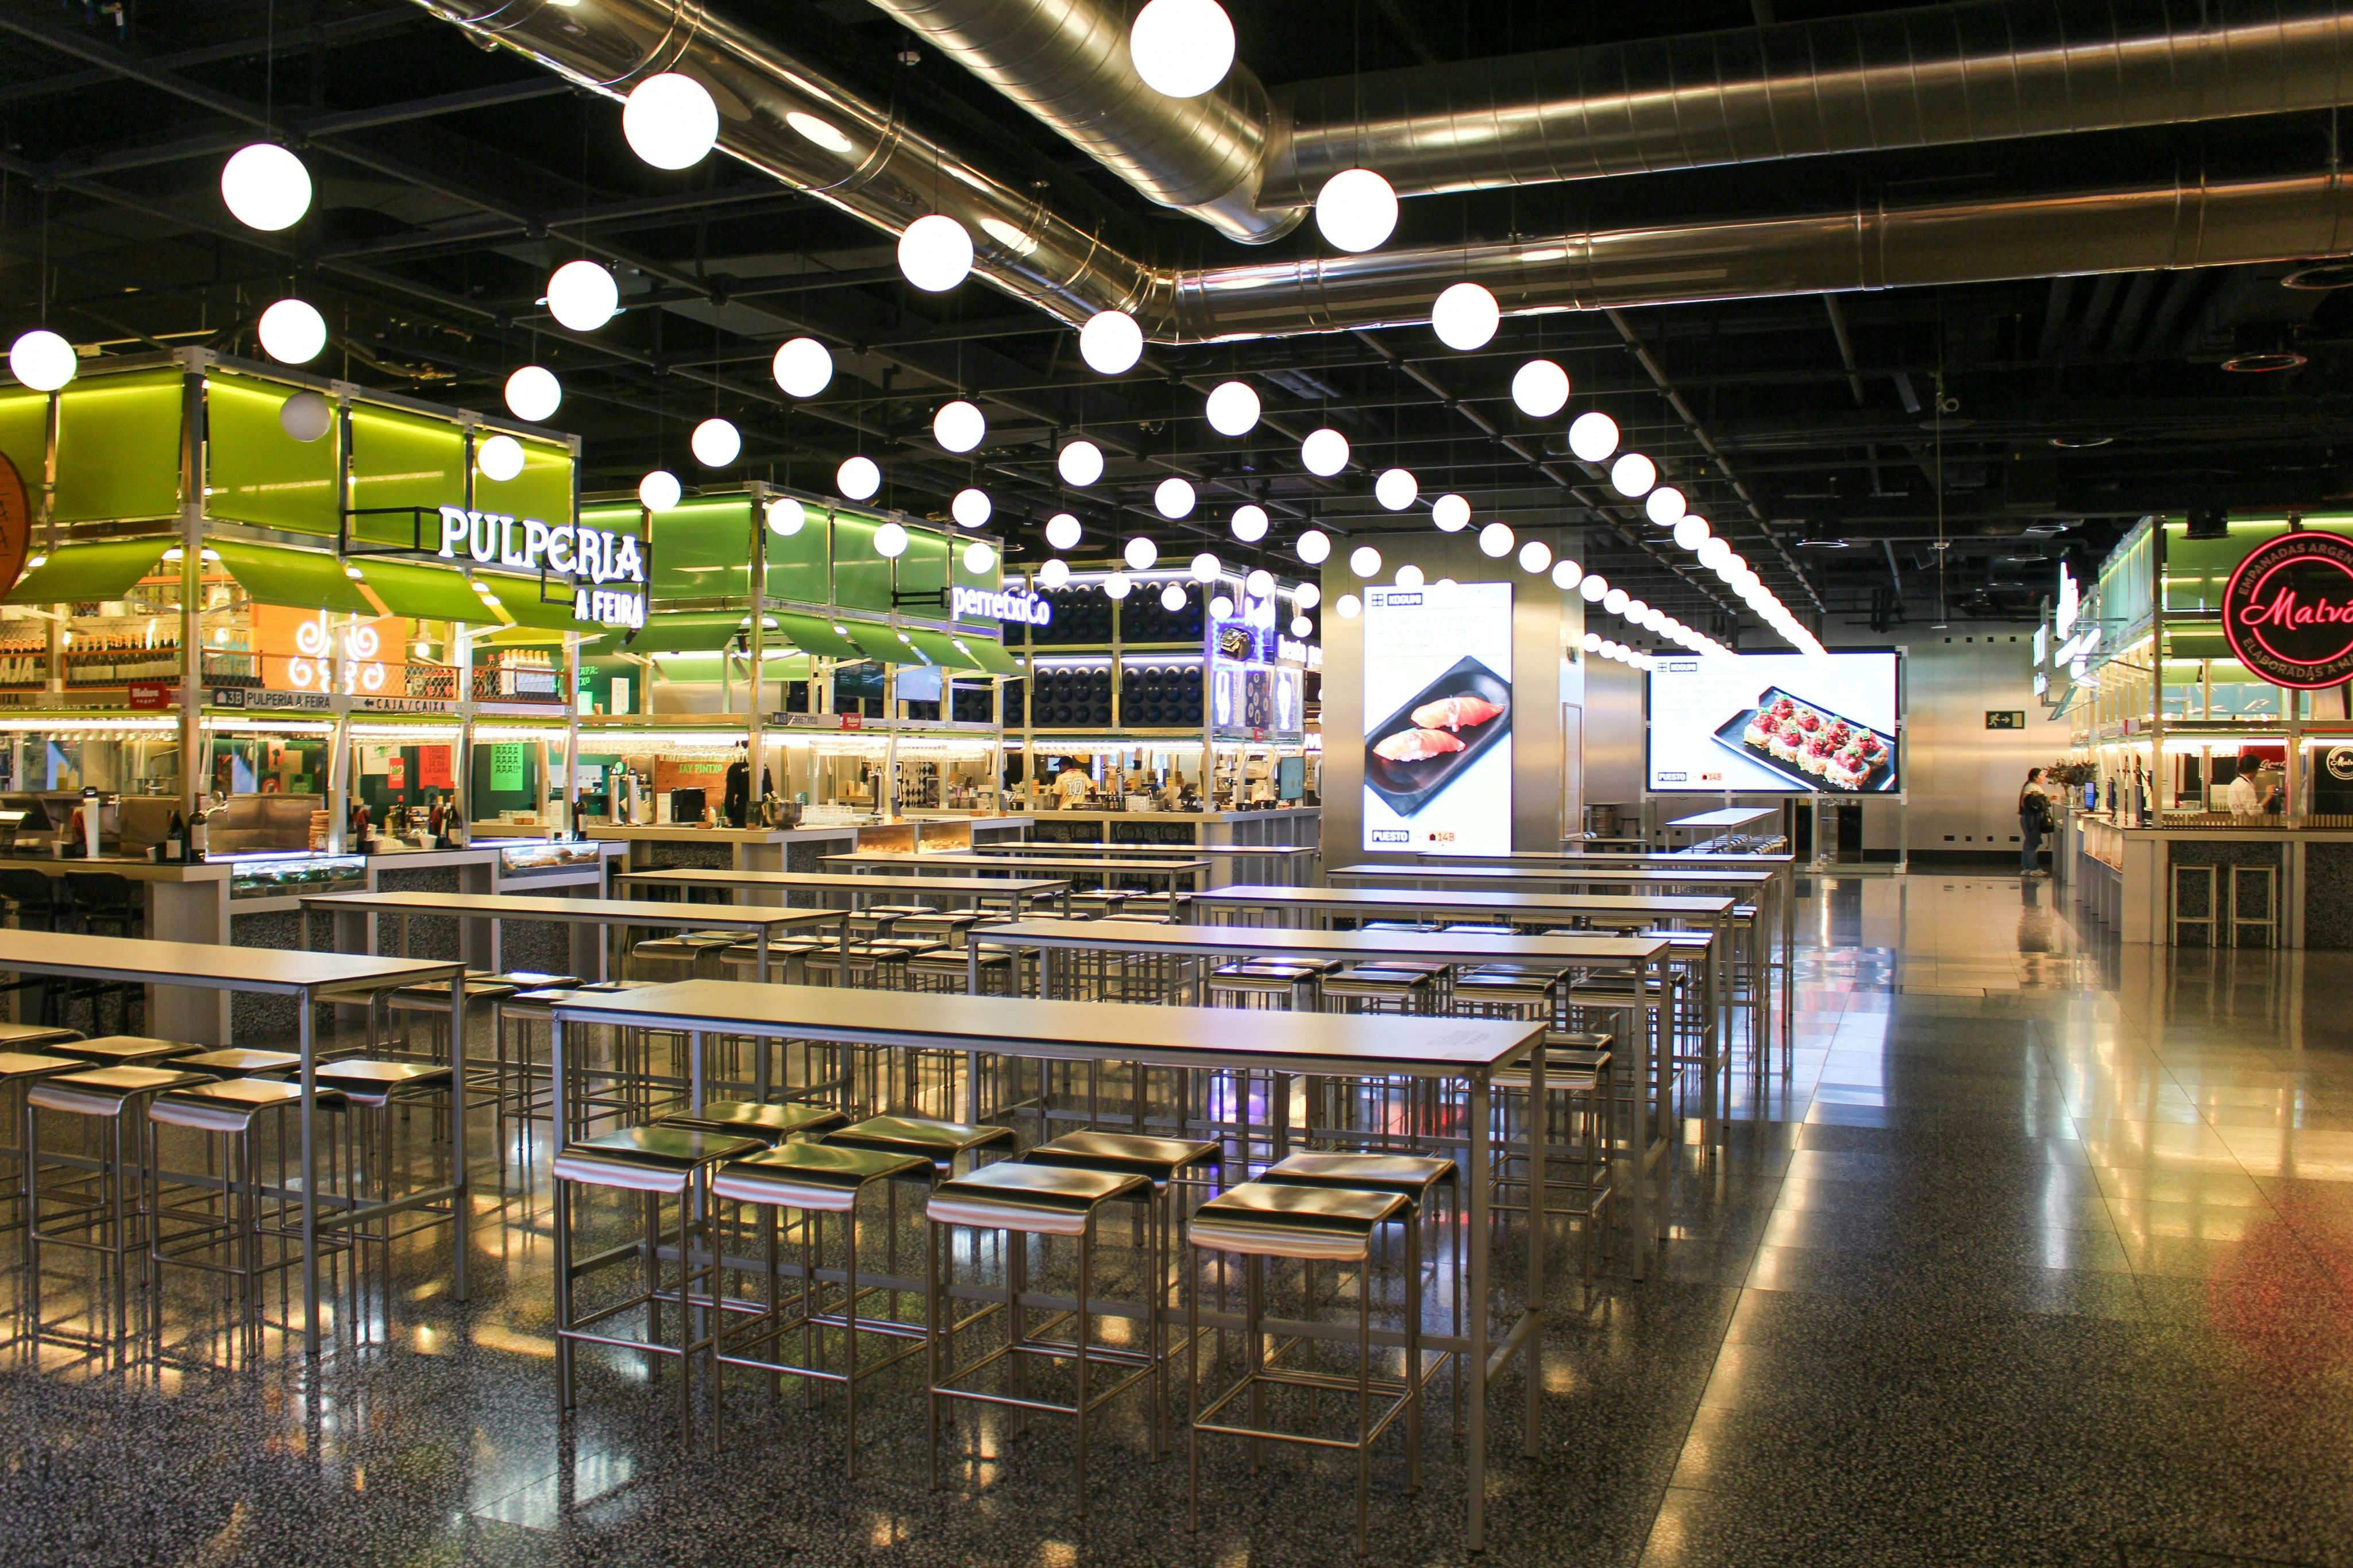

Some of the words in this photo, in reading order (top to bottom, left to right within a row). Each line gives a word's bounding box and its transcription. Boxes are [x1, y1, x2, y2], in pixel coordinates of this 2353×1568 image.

[438, 506, 644, 584] PULPERIA
[2239, 543, 2305, 596] EMPANADAS
[575, 589, 589, 620] A
[592, 590, 644, 628] FEIRA
[2243, 638, 2324, 678] ELABORADAS
[2328, 665, 2337, 675] A
[228, 692, 242, 704] 3B
[296, 697, 302, 706] A
[305, 696, 330, 708] FEIRA
[678, 764, 692, 773] SAY
[694, 763, 723, 774] PINTXO
[1658, 773, 1686, 781] PUESTO
[1067, 779, 1083, 796] 10
[1373, 831, 1408, 841] PUESTO
[1437, 832, 1455, 841] 14B
